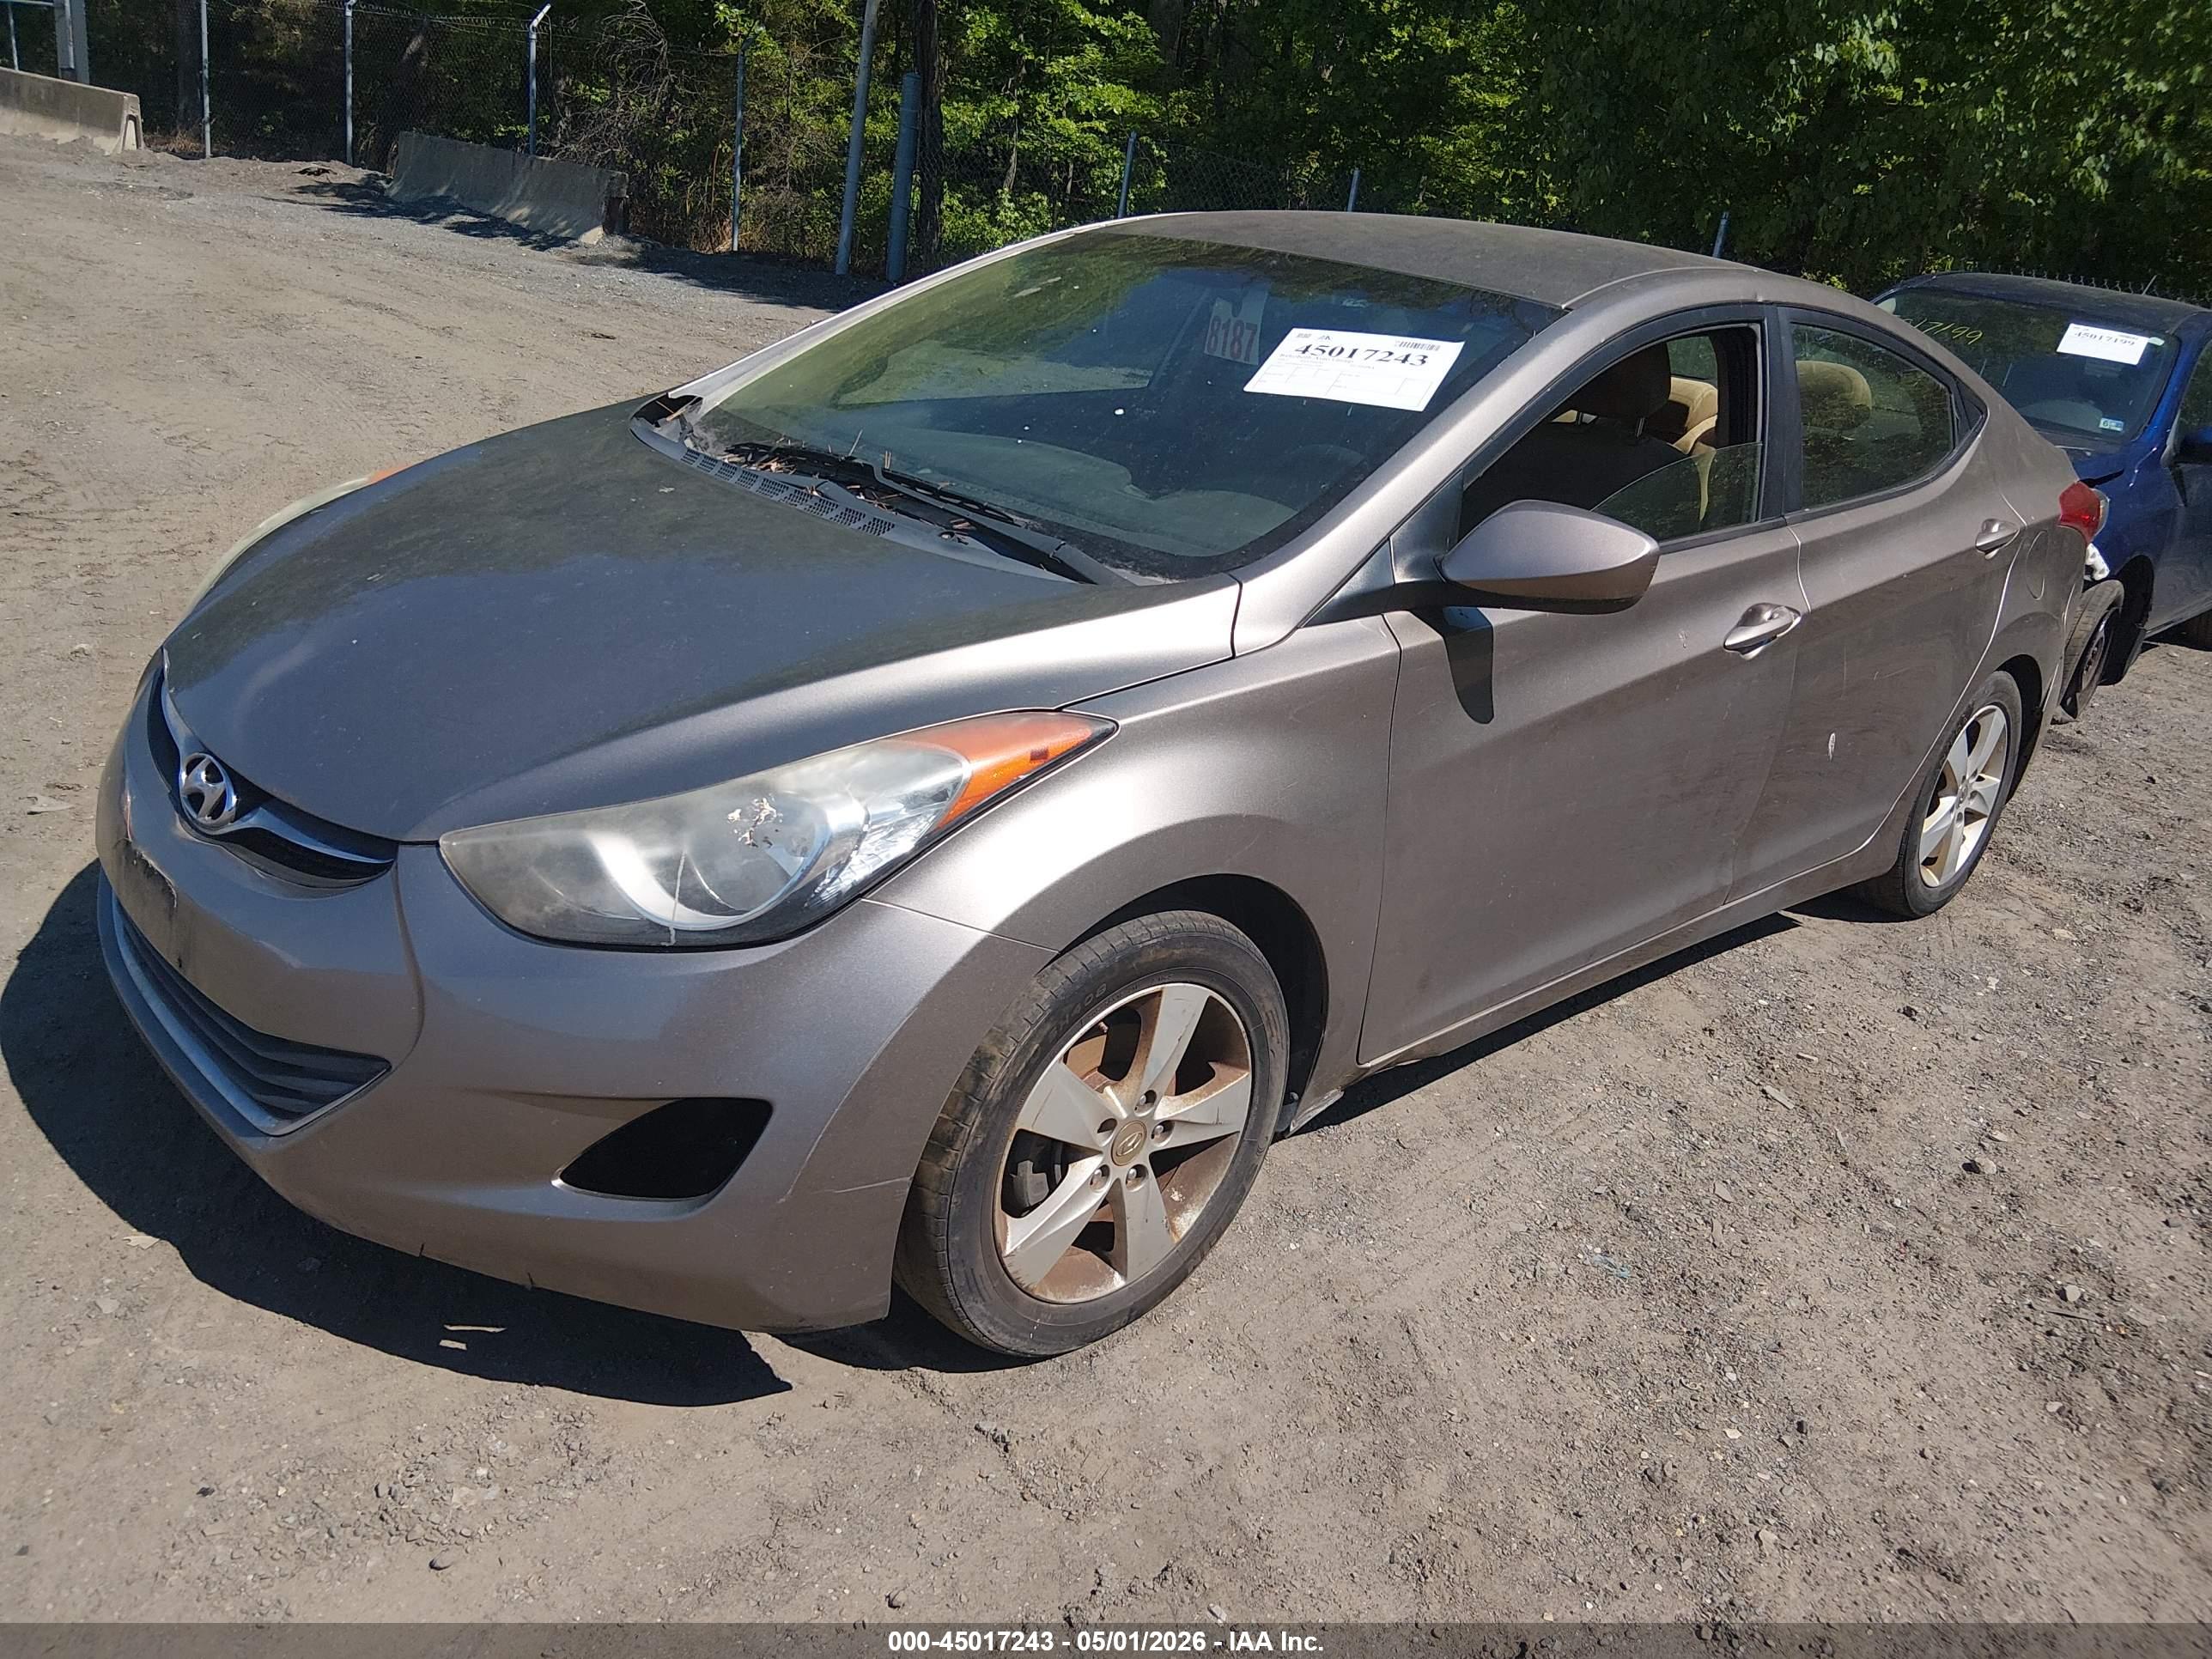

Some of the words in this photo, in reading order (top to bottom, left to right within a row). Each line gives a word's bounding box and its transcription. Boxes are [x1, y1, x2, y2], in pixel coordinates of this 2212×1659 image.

[1208, 315, 1258, 362] 8187
[2075, 331, 2136, 346] 45017199
[1294, 343, 1429, 367] 45017243
